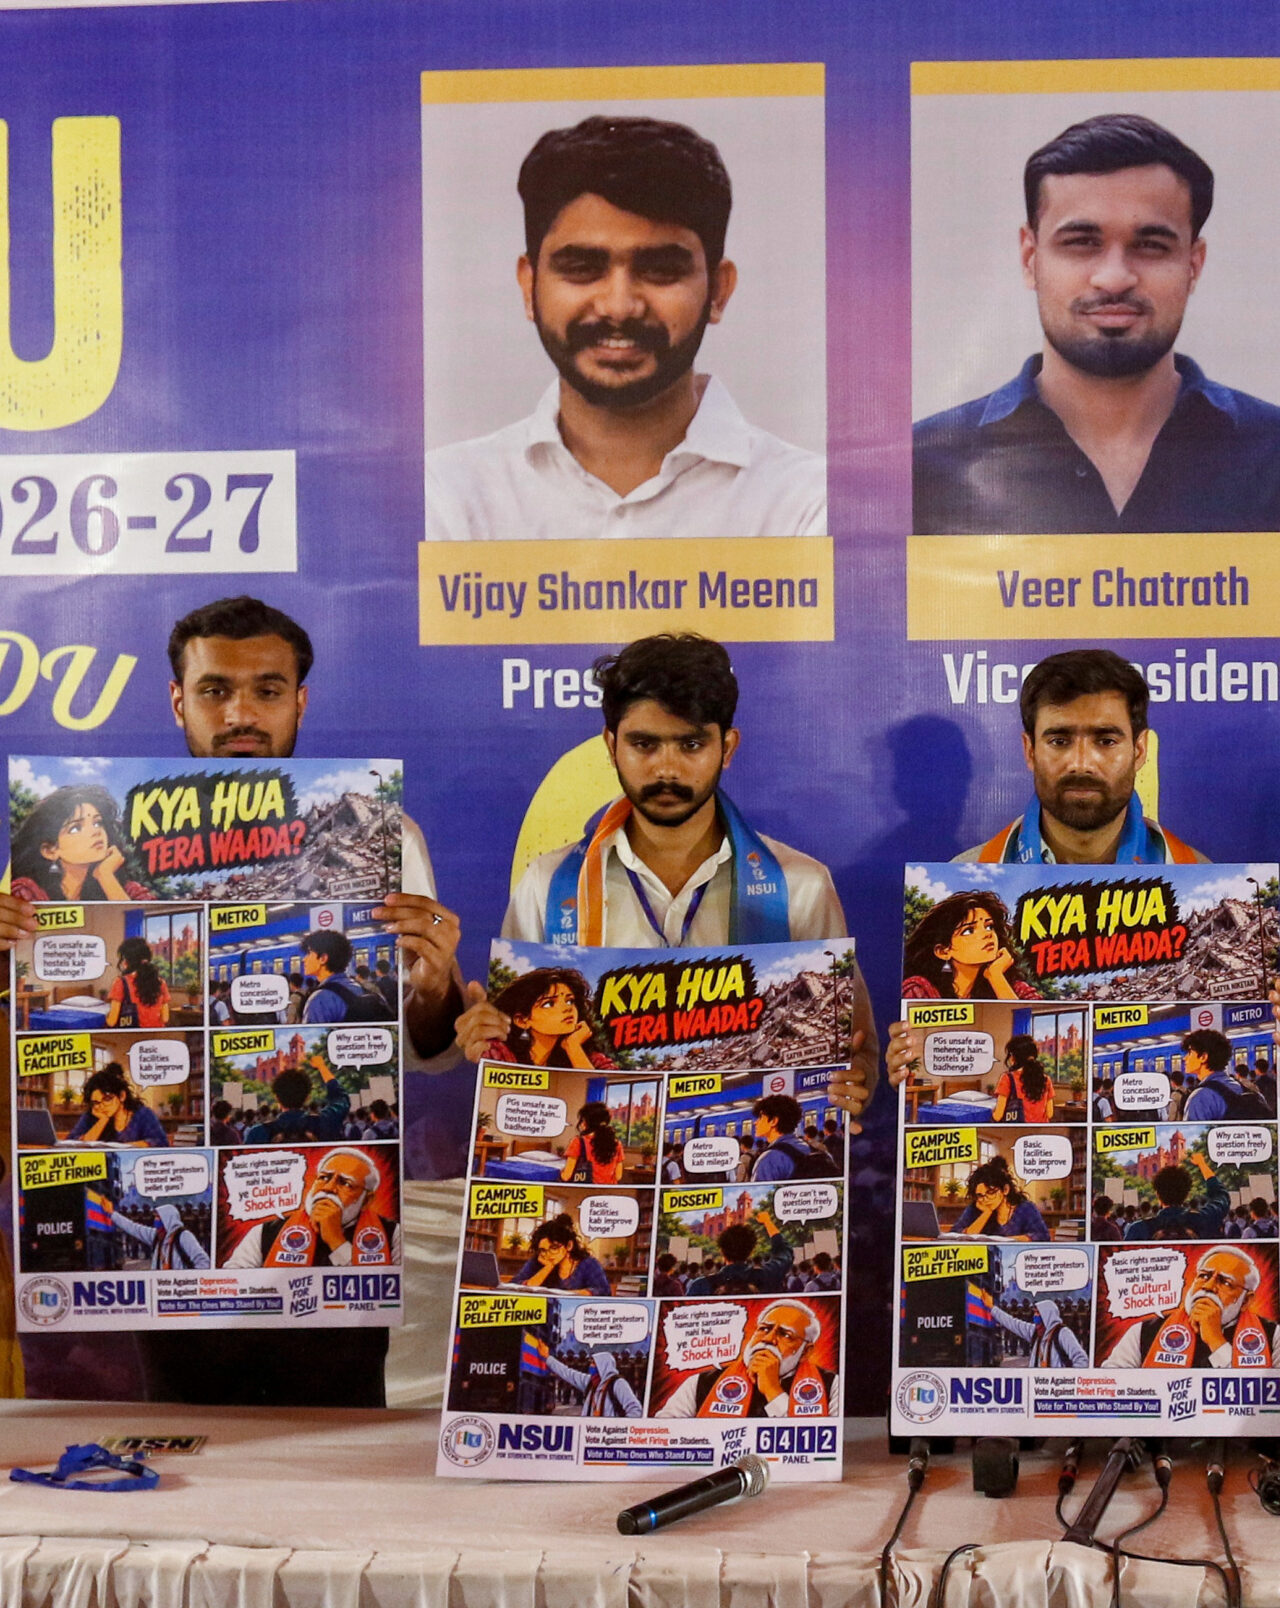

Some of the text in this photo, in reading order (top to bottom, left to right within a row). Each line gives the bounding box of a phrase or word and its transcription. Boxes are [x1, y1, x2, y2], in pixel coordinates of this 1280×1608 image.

[0, 473, 274, 556] 26-27
[438, 570, 818, 619] Vijay Shankar Meena
[996, 566, 1249, 608] Veer Chatrath
[942, 650, 1030, 704] Vic
[131, 779, 285, 838] KYA HUA
[142, 820, 306, 873] TERA WAADA?
[747, 883, 777, 896] NSUI
[217, 909, 259, 926] METRO
[1021, 887, 1166, 941] KYA HUA
[1031, 925, 1187, 975] TERA WAADA?
[239, 980, 261, 989] Metro
[601, 965, 745, 1016] KYA HUA
[239, 989, 278, 997] concession
[240, 996, 283, 1007] kab milega?
[610, 998, 764, 1047] TERA WAADA?
[914, 1008, 967, 1024] HOSTELS
[1101, 1009, 1141, 1025] METRO
[1232, 1007, 1262, 1022] METRO
[23, 1038, 73, 1057] CAMPUS
[220, 1034, 269, 1052] DISSENT
[24, 1051, 86, 1072] FACILITIES
[488, 1072, 542, 1086] HOSTELS
[675, 1078, 715, 1094] METRO
[911, 1131, 960, 1149] CAMPUS
[1103, 1131, 1150, 1148] DISSENT
[1215, 1131, 1231, 1141] Why
[1232, 1131, 1250, 1139] can't
[1215, 1139, 1267, 1151] question freely
[49, 1155, 77, 1169] JULY
[911, 1144, 972, 1164] FACILITIES
[1227, 1149, 1258, 1159] campus?
[25, 1165, 104, 1186] PELLET FIRING
[476, 1188, 527, 1203] CAMPUS
[670, 1192, 718, 1208] DISSENT
[475, 1201, 538, 1215] FACILITIES
[590, 1200, 609, 1208] Basic
[589, 1208, 619, 1217] facilities
[37, 1222, 73, 1235] POLICE
[588, 1216, 633, 1228] kab improve
[588, 1224, 616, 1235] honge?
[932, 1248, 960, 1262] JULY
[908, 1258, 985, 1278] PELLET FIRING
[73, 1280, 145, 1306] NSUI
[490, 1298, 518, 1310] JULY
[464, 1310, 543, 1325] PELLET FIRING
[917, 1316, 953, 1328] POLICE
[469, 1362, 507, 1375] POLICE
[950, 1377, 1022, 1405] NSUI
[711, 1402, 742, 1416] ABVP
[498, 1424, 574, 1452] NSUI
